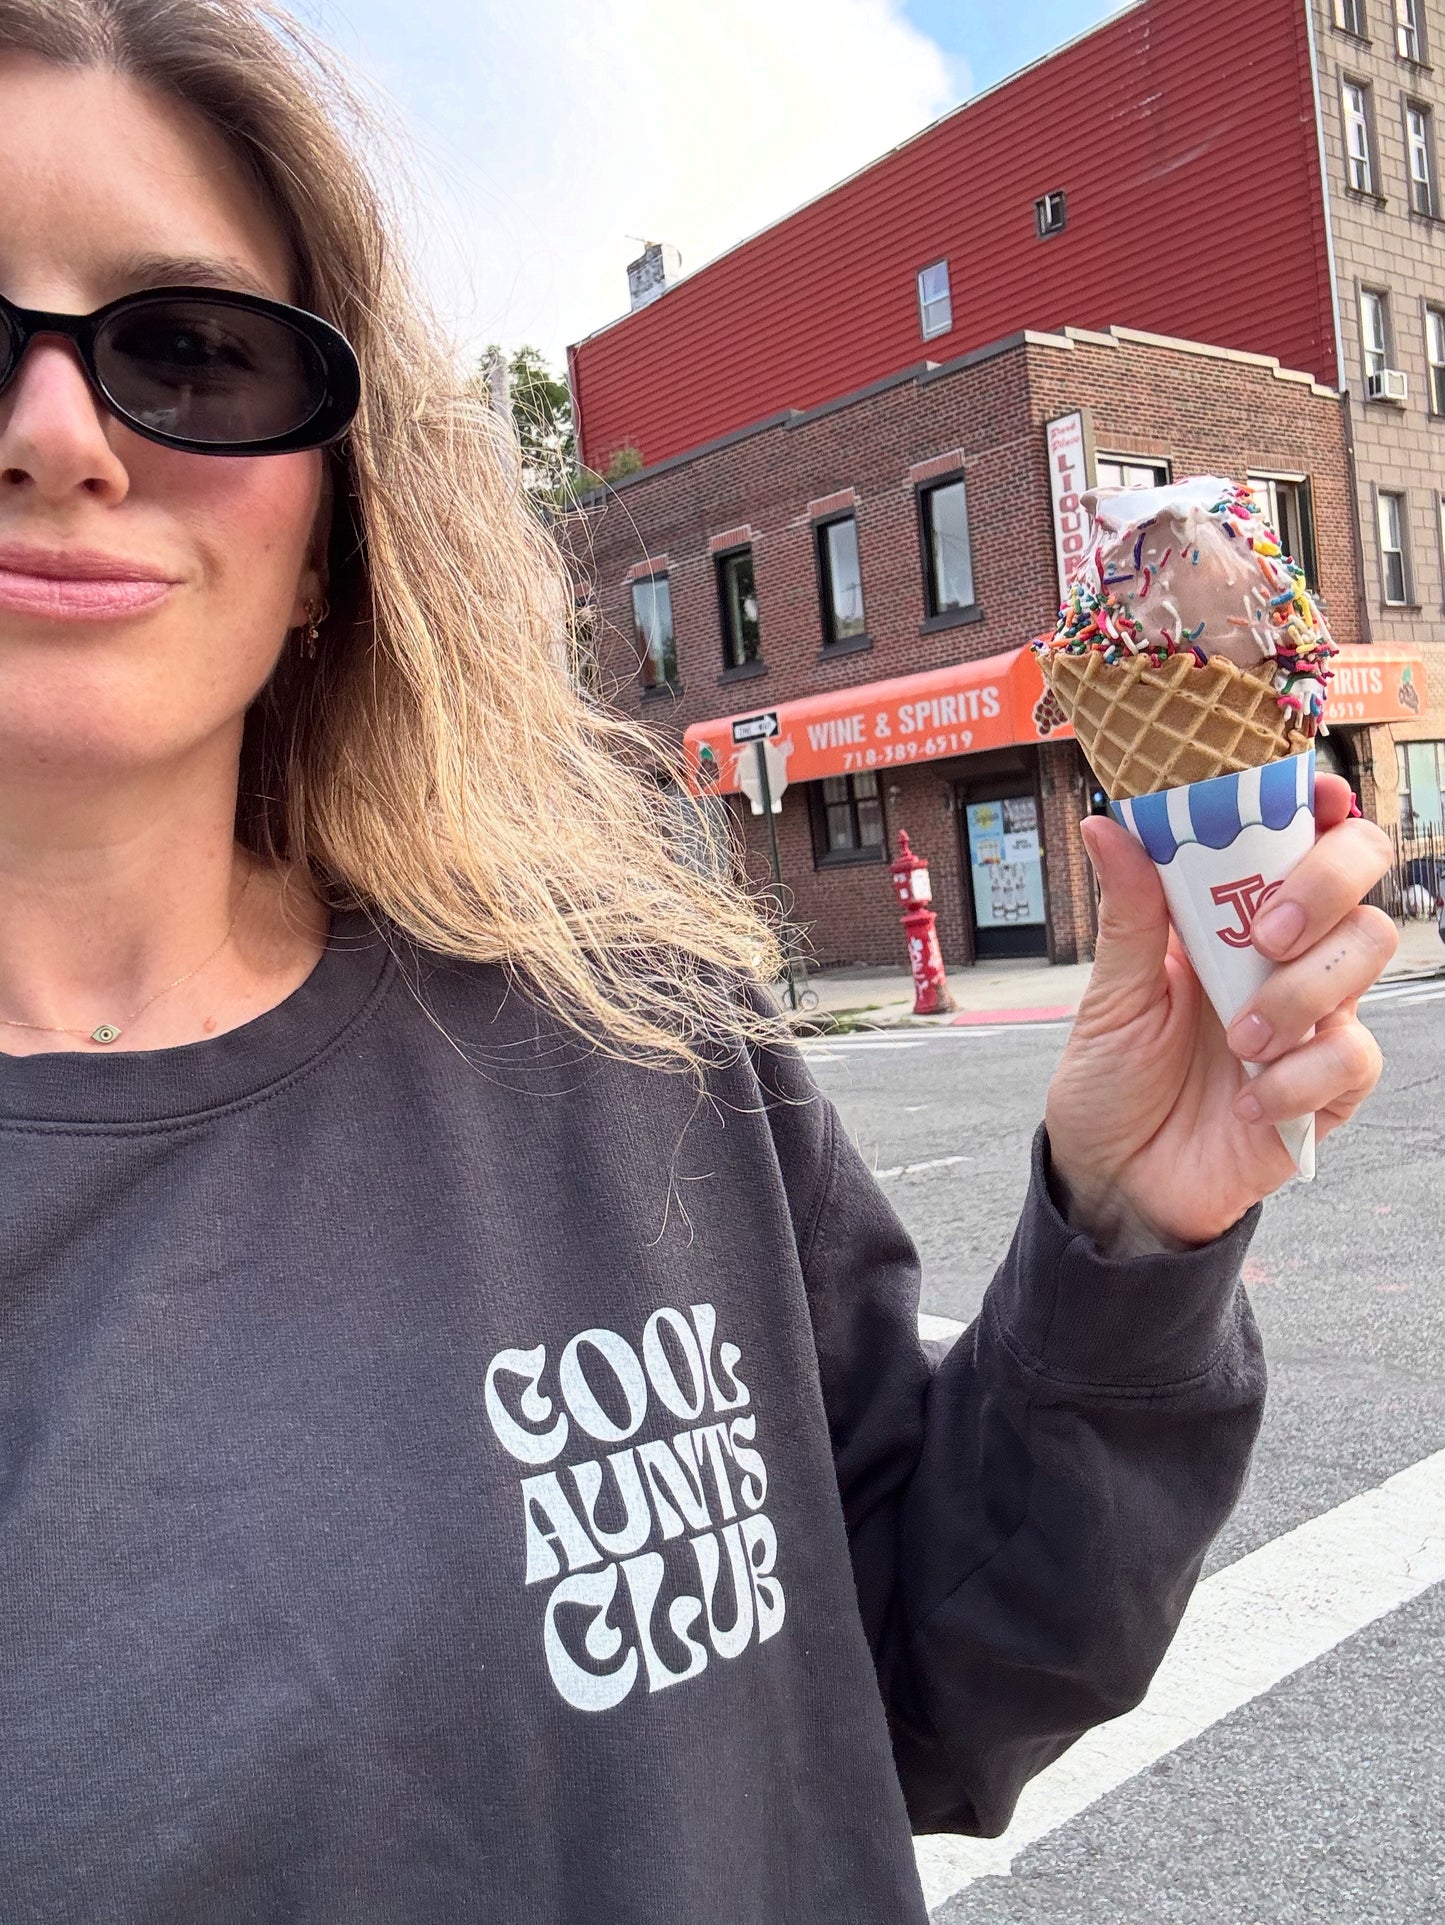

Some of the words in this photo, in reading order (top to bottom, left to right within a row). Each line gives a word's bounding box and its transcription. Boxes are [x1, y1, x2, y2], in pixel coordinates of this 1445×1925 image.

[807, 713, 866, 751] WINE
[875, 711, 892, 738] &
[898, 686, 1000, 735] SPIRITS
[485, 1303, 751, 1464] COOL
[520, 1413, 769, 1585] AUNTS
[543, 1513, 786, 1712] CLUB
